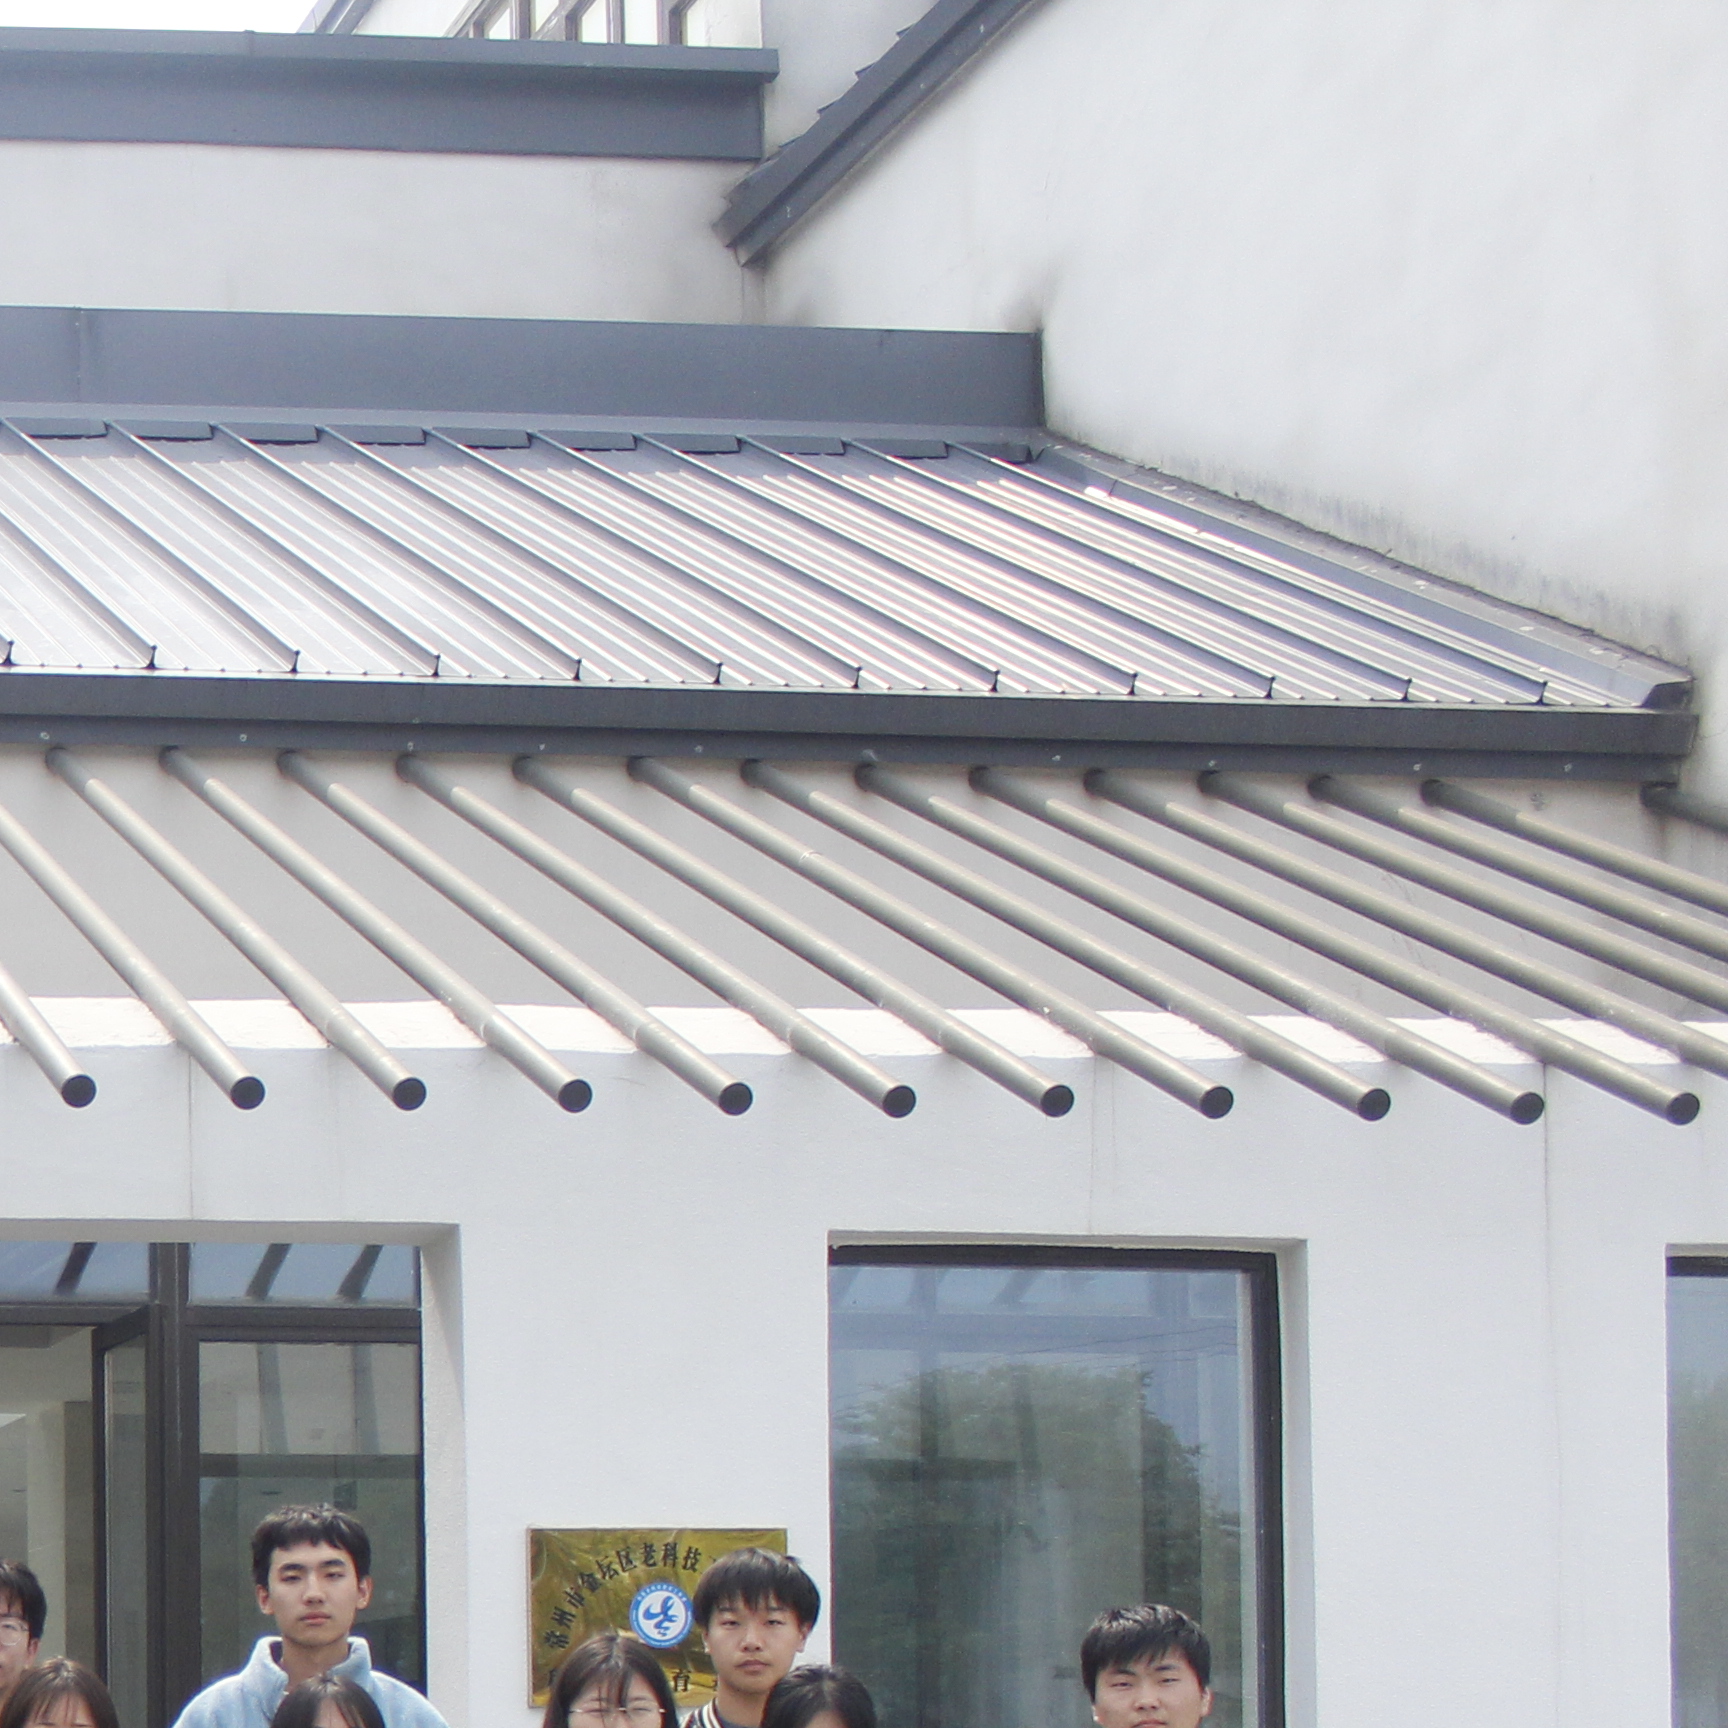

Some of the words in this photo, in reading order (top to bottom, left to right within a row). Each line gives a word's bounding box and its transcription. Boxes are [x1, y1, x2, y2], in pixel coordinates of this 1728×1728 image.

[544, 1541, 718, 1649] 常州市金坛区老科技
